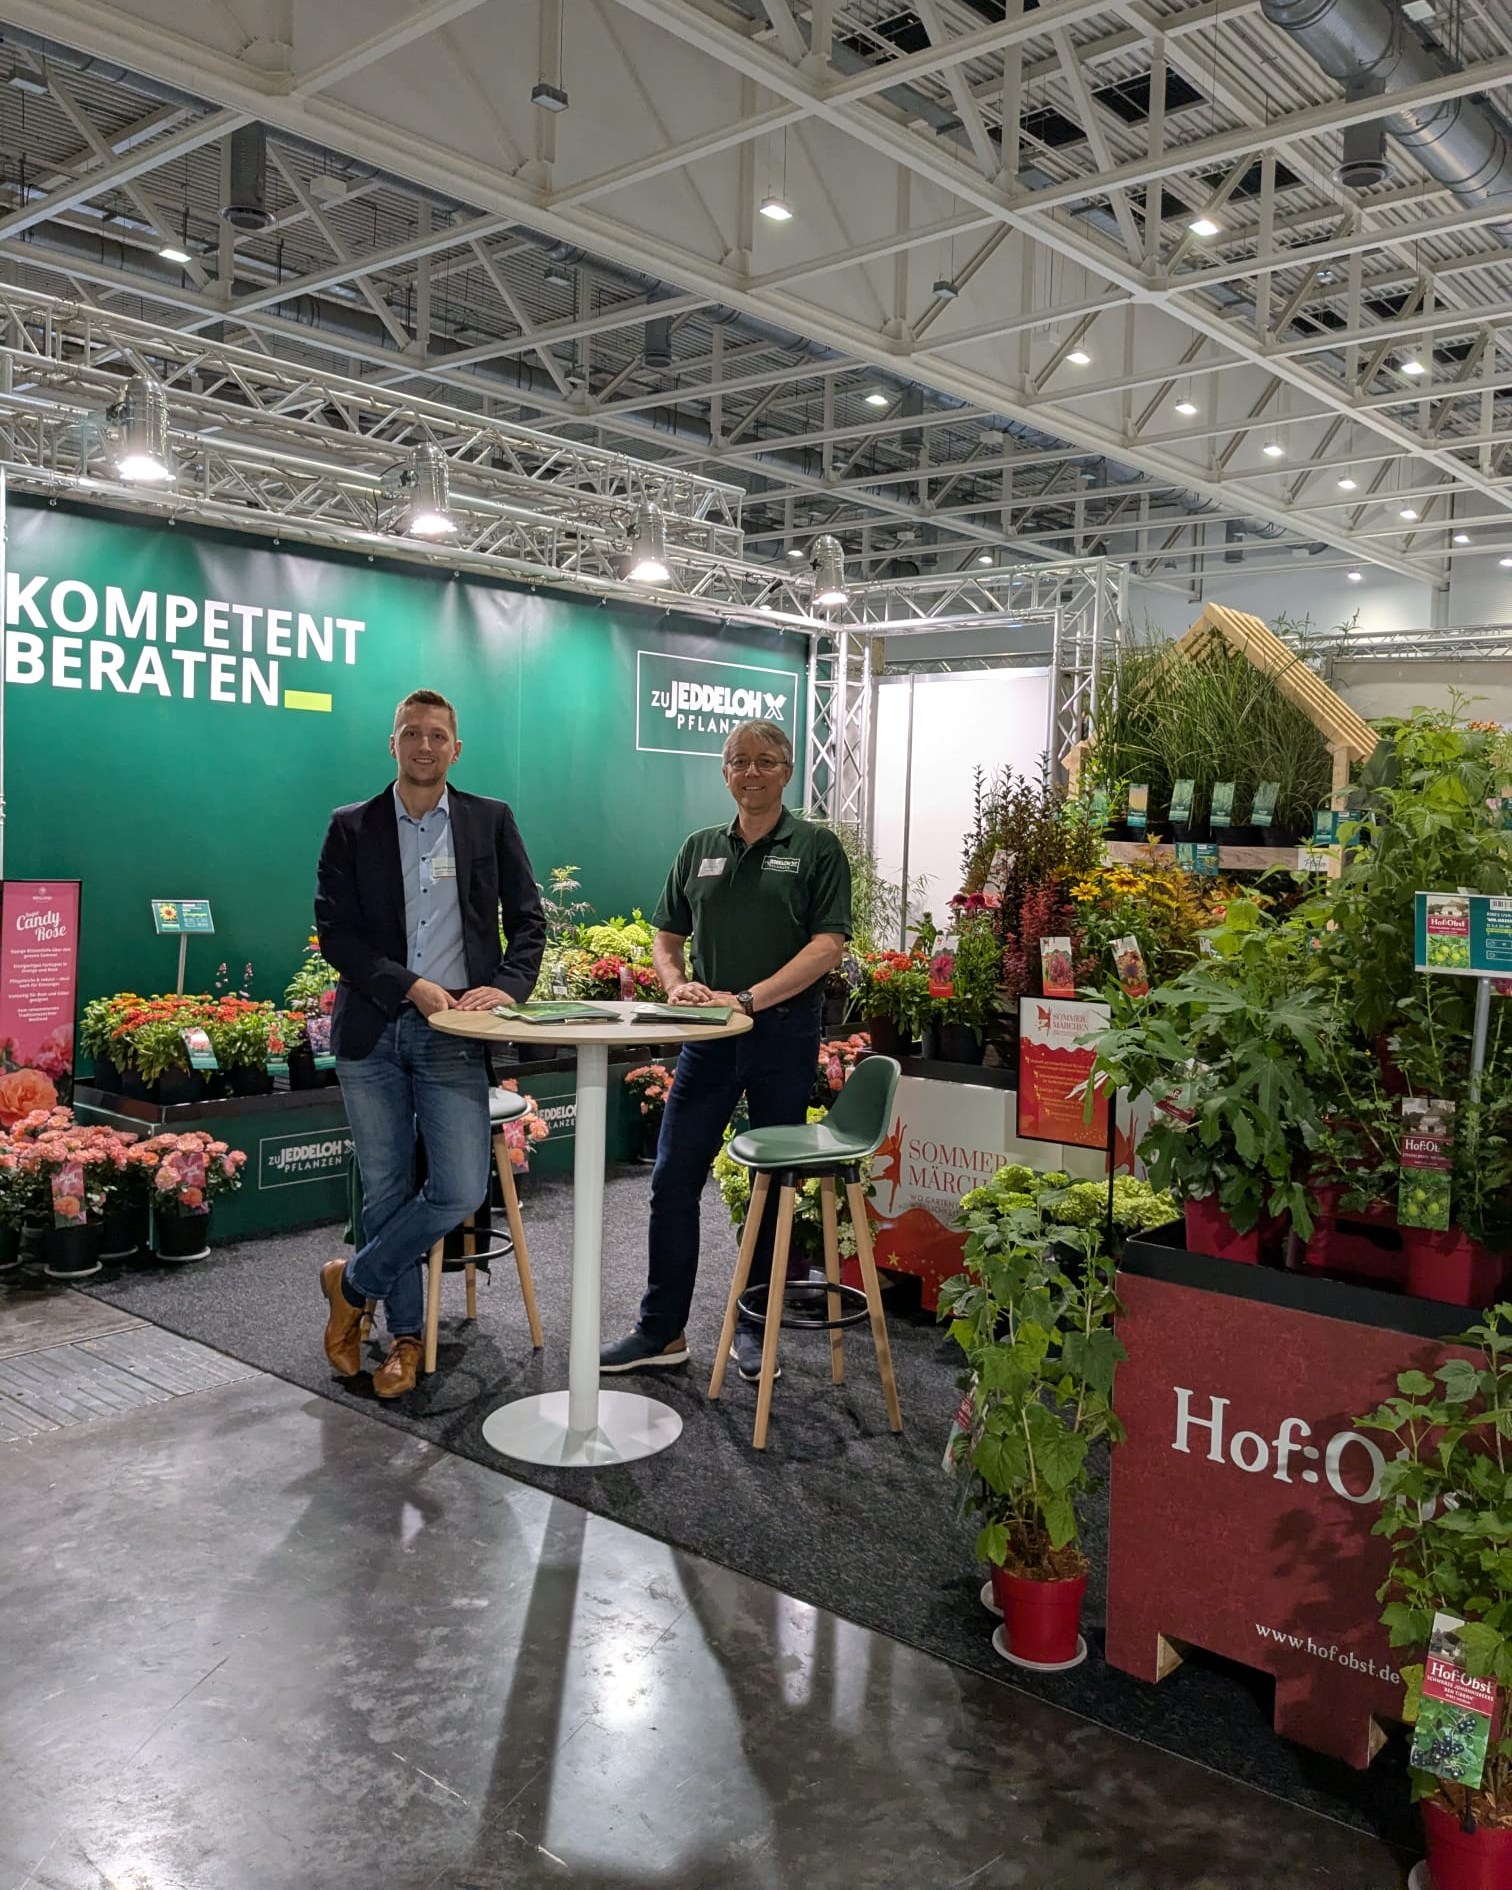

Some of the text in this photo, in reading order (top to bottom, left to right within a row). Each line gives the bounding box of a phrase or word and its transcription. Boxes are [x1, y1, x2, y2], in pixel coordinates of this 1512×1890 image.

[5, 572, 366, 664] KOMPETENT
[5, 630, 279, 706] BERATEN
[16, 910, 61, 931] Candy
[35, 924, 67, 942] Rose
[284, 1156, 342, 1173] PFLANZEN
[1430, 1661, 1492, 1694] Hof:Obst
